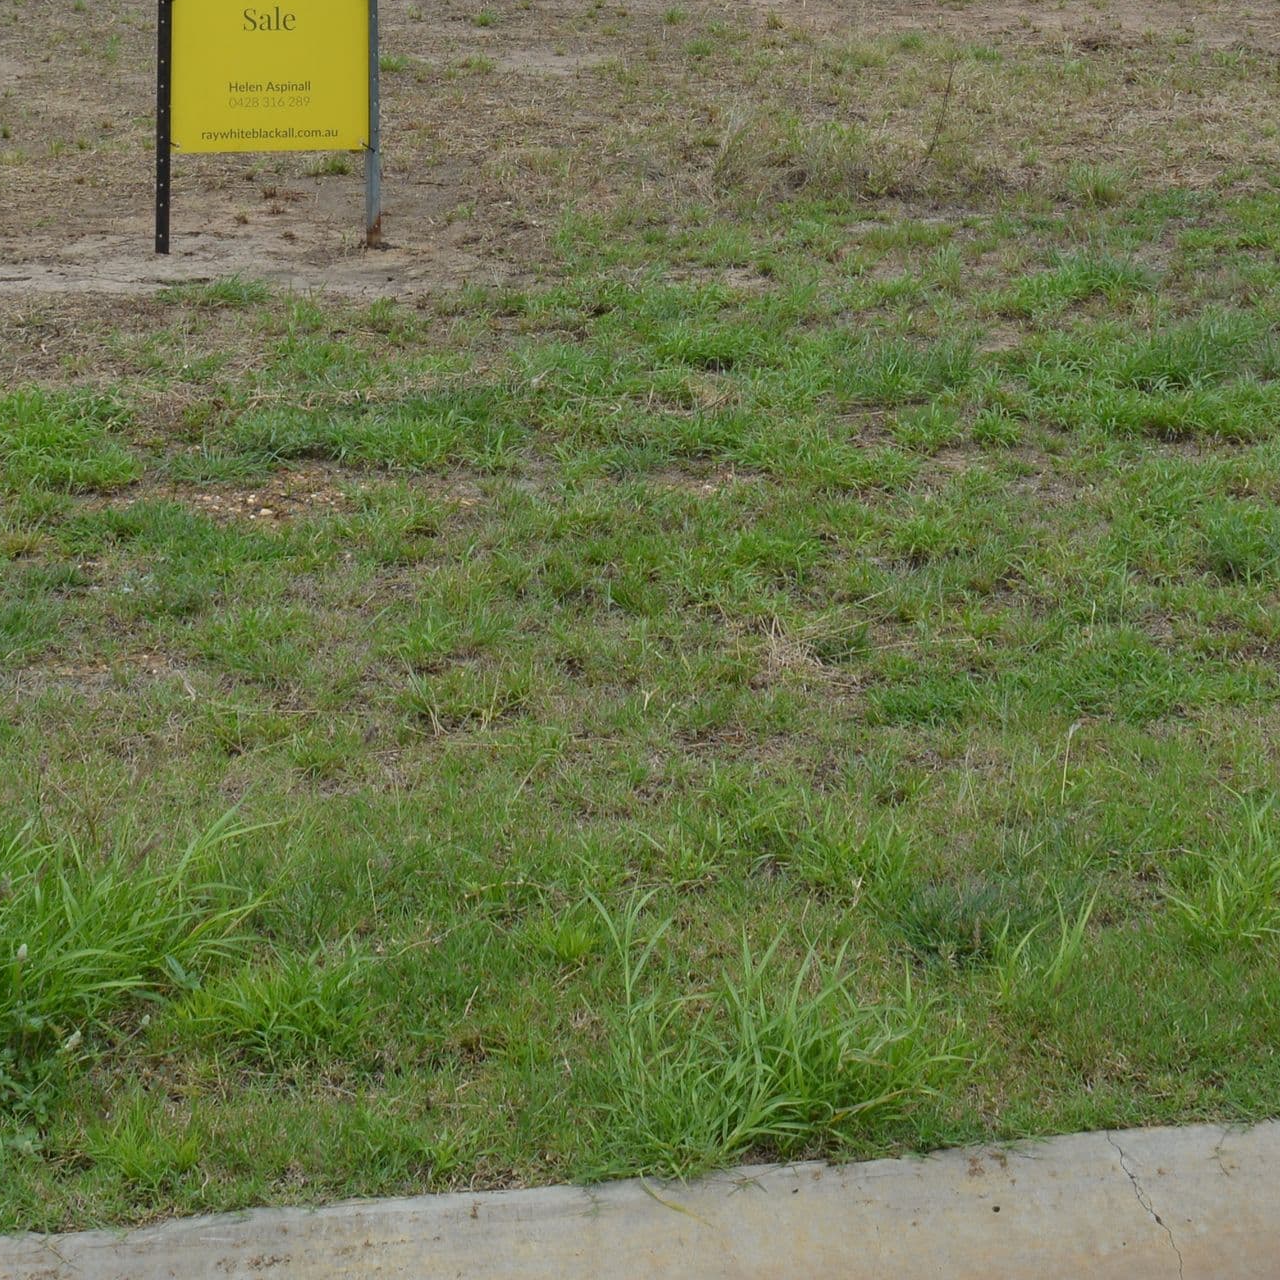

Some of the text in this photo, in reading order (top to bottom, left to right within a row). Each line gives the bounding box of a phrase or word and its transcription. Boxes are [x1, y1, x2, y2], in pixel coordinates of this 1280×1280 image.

[243, 6, 296, 31] Sale
[228, 81, 311, 93] Helen Aspinall
[228, 96, 311, 108] 0428 316 289
[201, 128, 338, 140] raywhiteblackall.com.au
